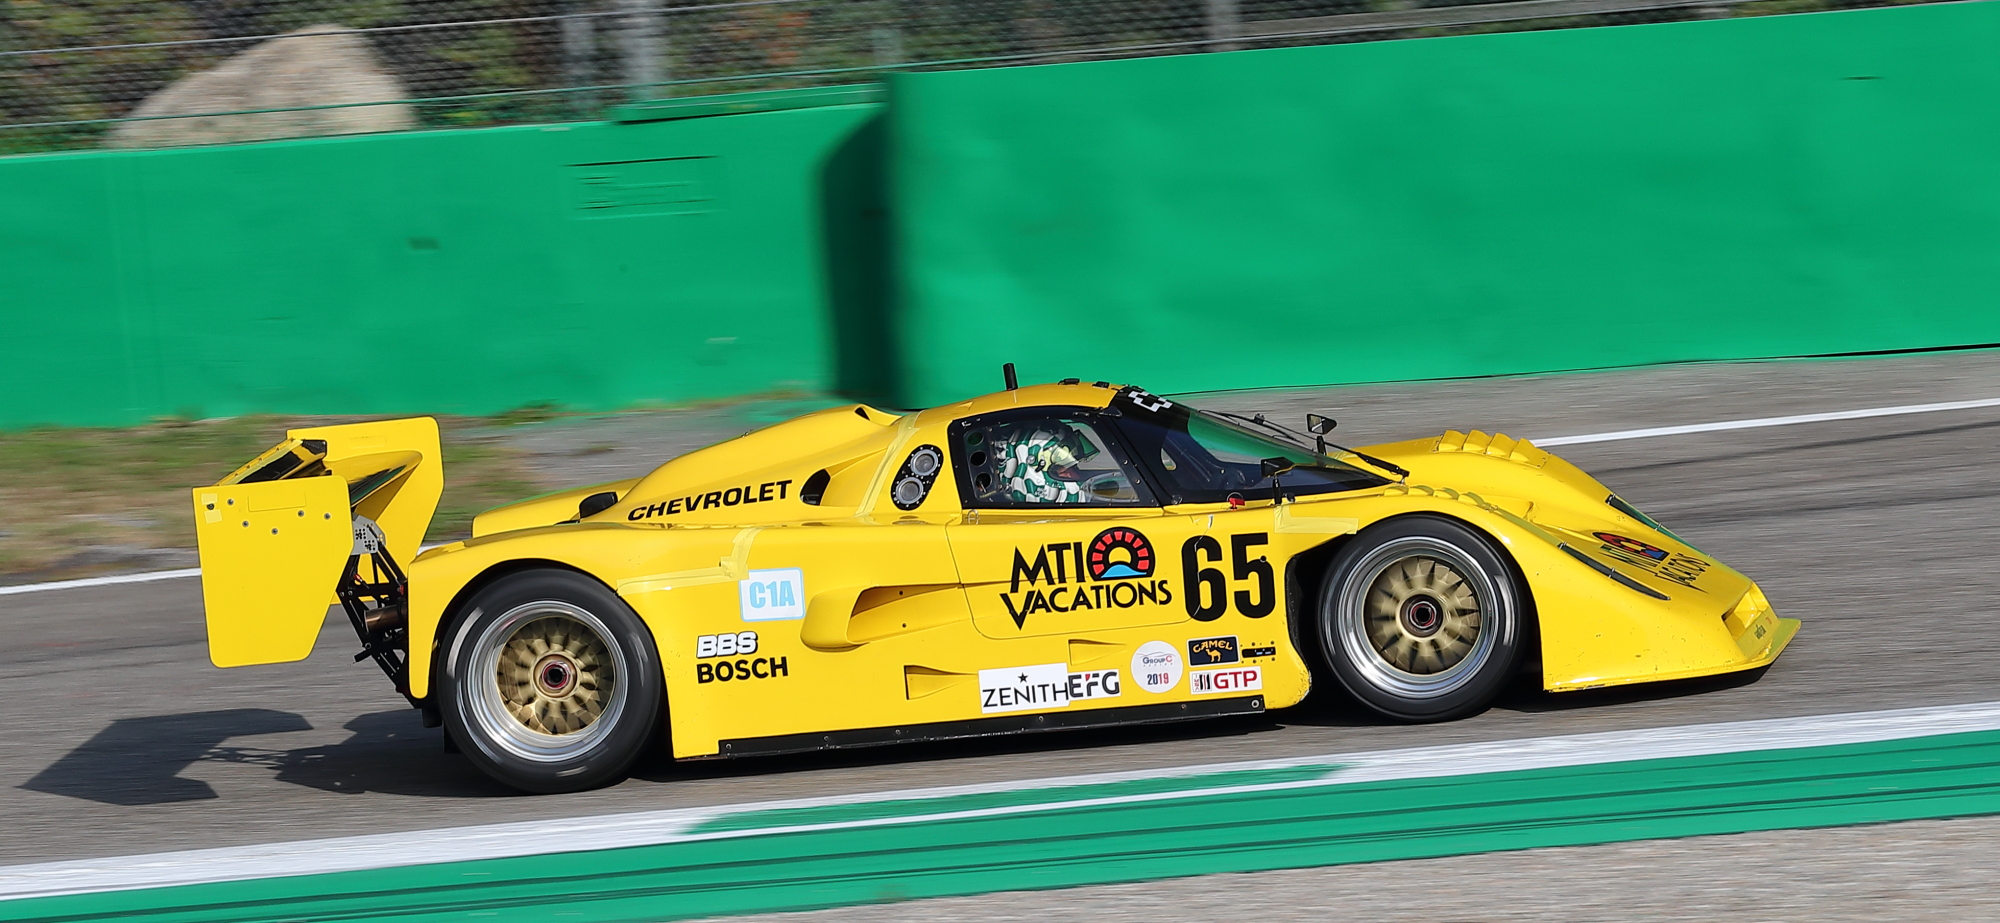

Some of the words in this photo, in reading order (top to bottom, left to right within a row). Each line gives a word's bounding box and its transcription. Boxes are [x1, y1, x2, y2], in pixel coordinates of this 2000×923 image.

[628, 480, 792, 521] CHEVROLET
[1010, 541, 1086, 593] MTI
[1181, 532, 1276, 622] 65
[749, 580, 796, 609] C1A
[1000, 579, 1172, 631] VACATIONS
[696, 631, 758, 658] BBS
[1192, 639, 1233, 653] CAMEL
[696, 656, 789, 684] BOSCH
[1147, 672, 1169, 685] 2019
[1213, 670, 1258, 690] GTP
[982, 681, 1070, 709] ZENITH
[1069, 671, 1120, 698] EFG
